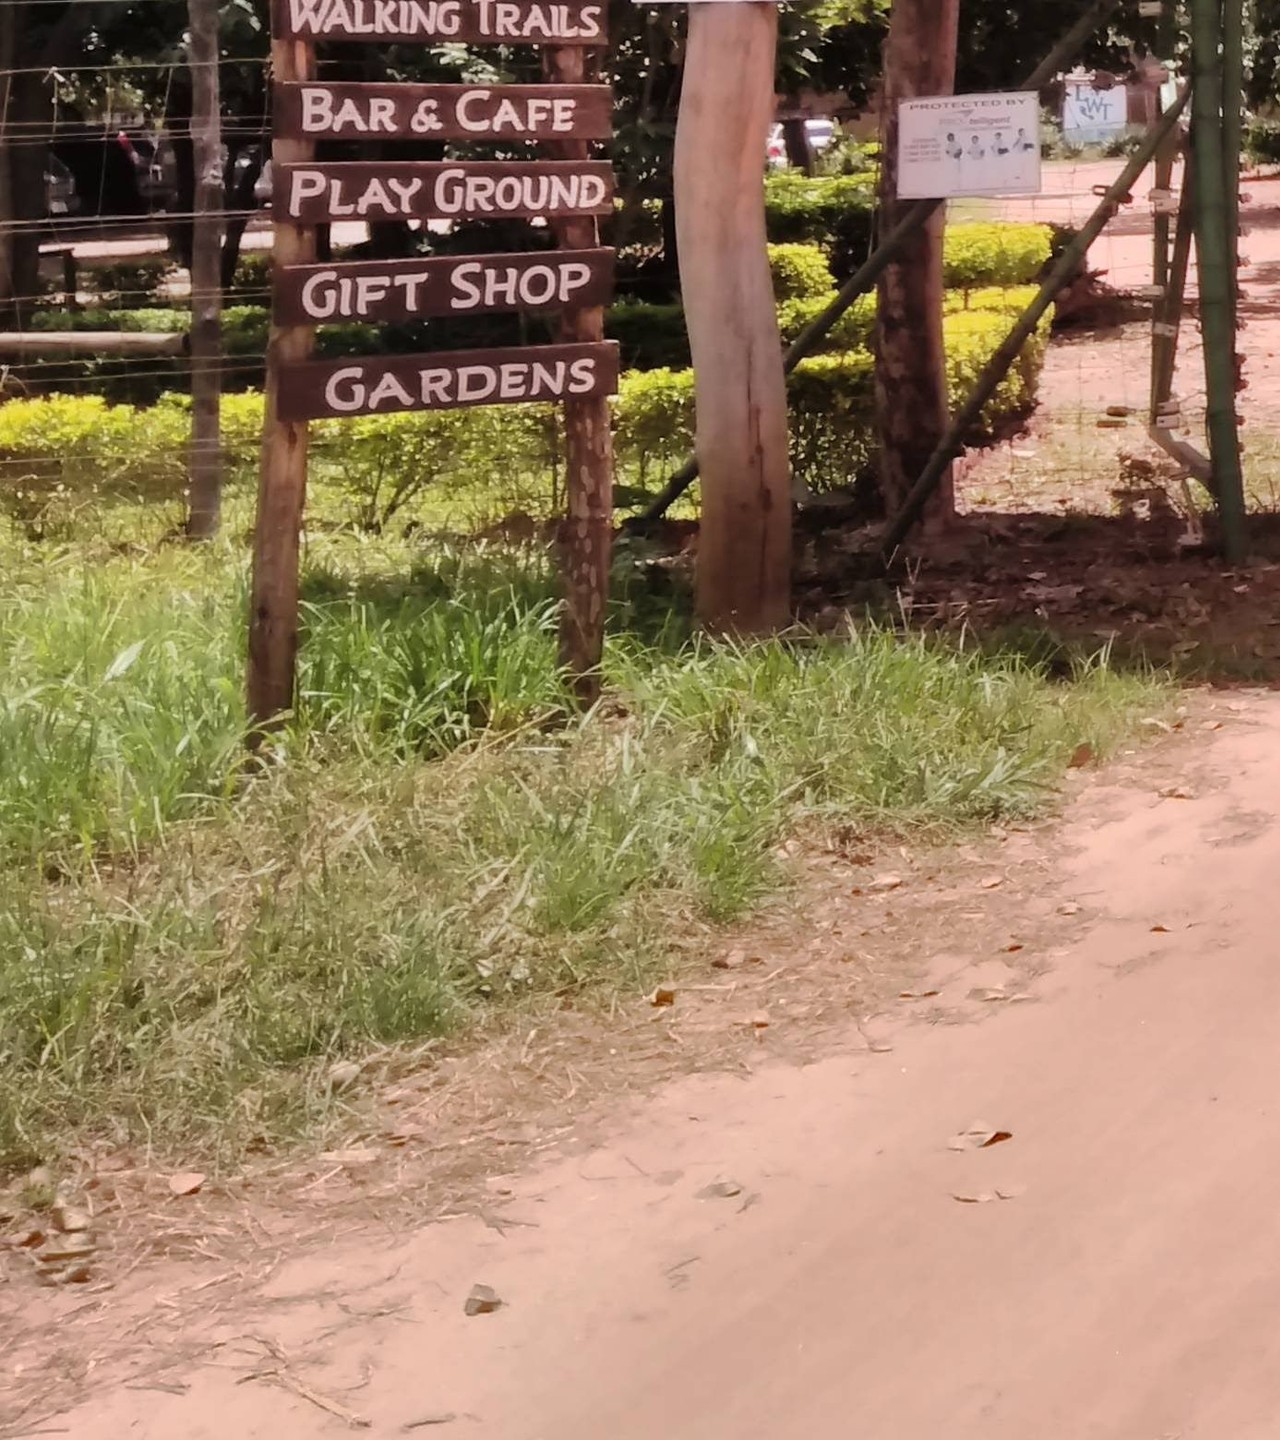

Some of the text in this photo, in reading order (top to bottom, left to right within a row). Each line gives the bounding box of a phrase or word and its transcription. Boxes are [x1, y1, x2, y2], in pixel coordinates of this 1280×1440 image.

[300, 88, 577, 134] BAR & CAFE
[909, 98, 1027, 110] PROTECTED BY
[288, 168, 606, 218] PLAY GROUND
[301, 261, 592, 319] GIFT SHOP
[324, 357, 596, 412] GARDENS
